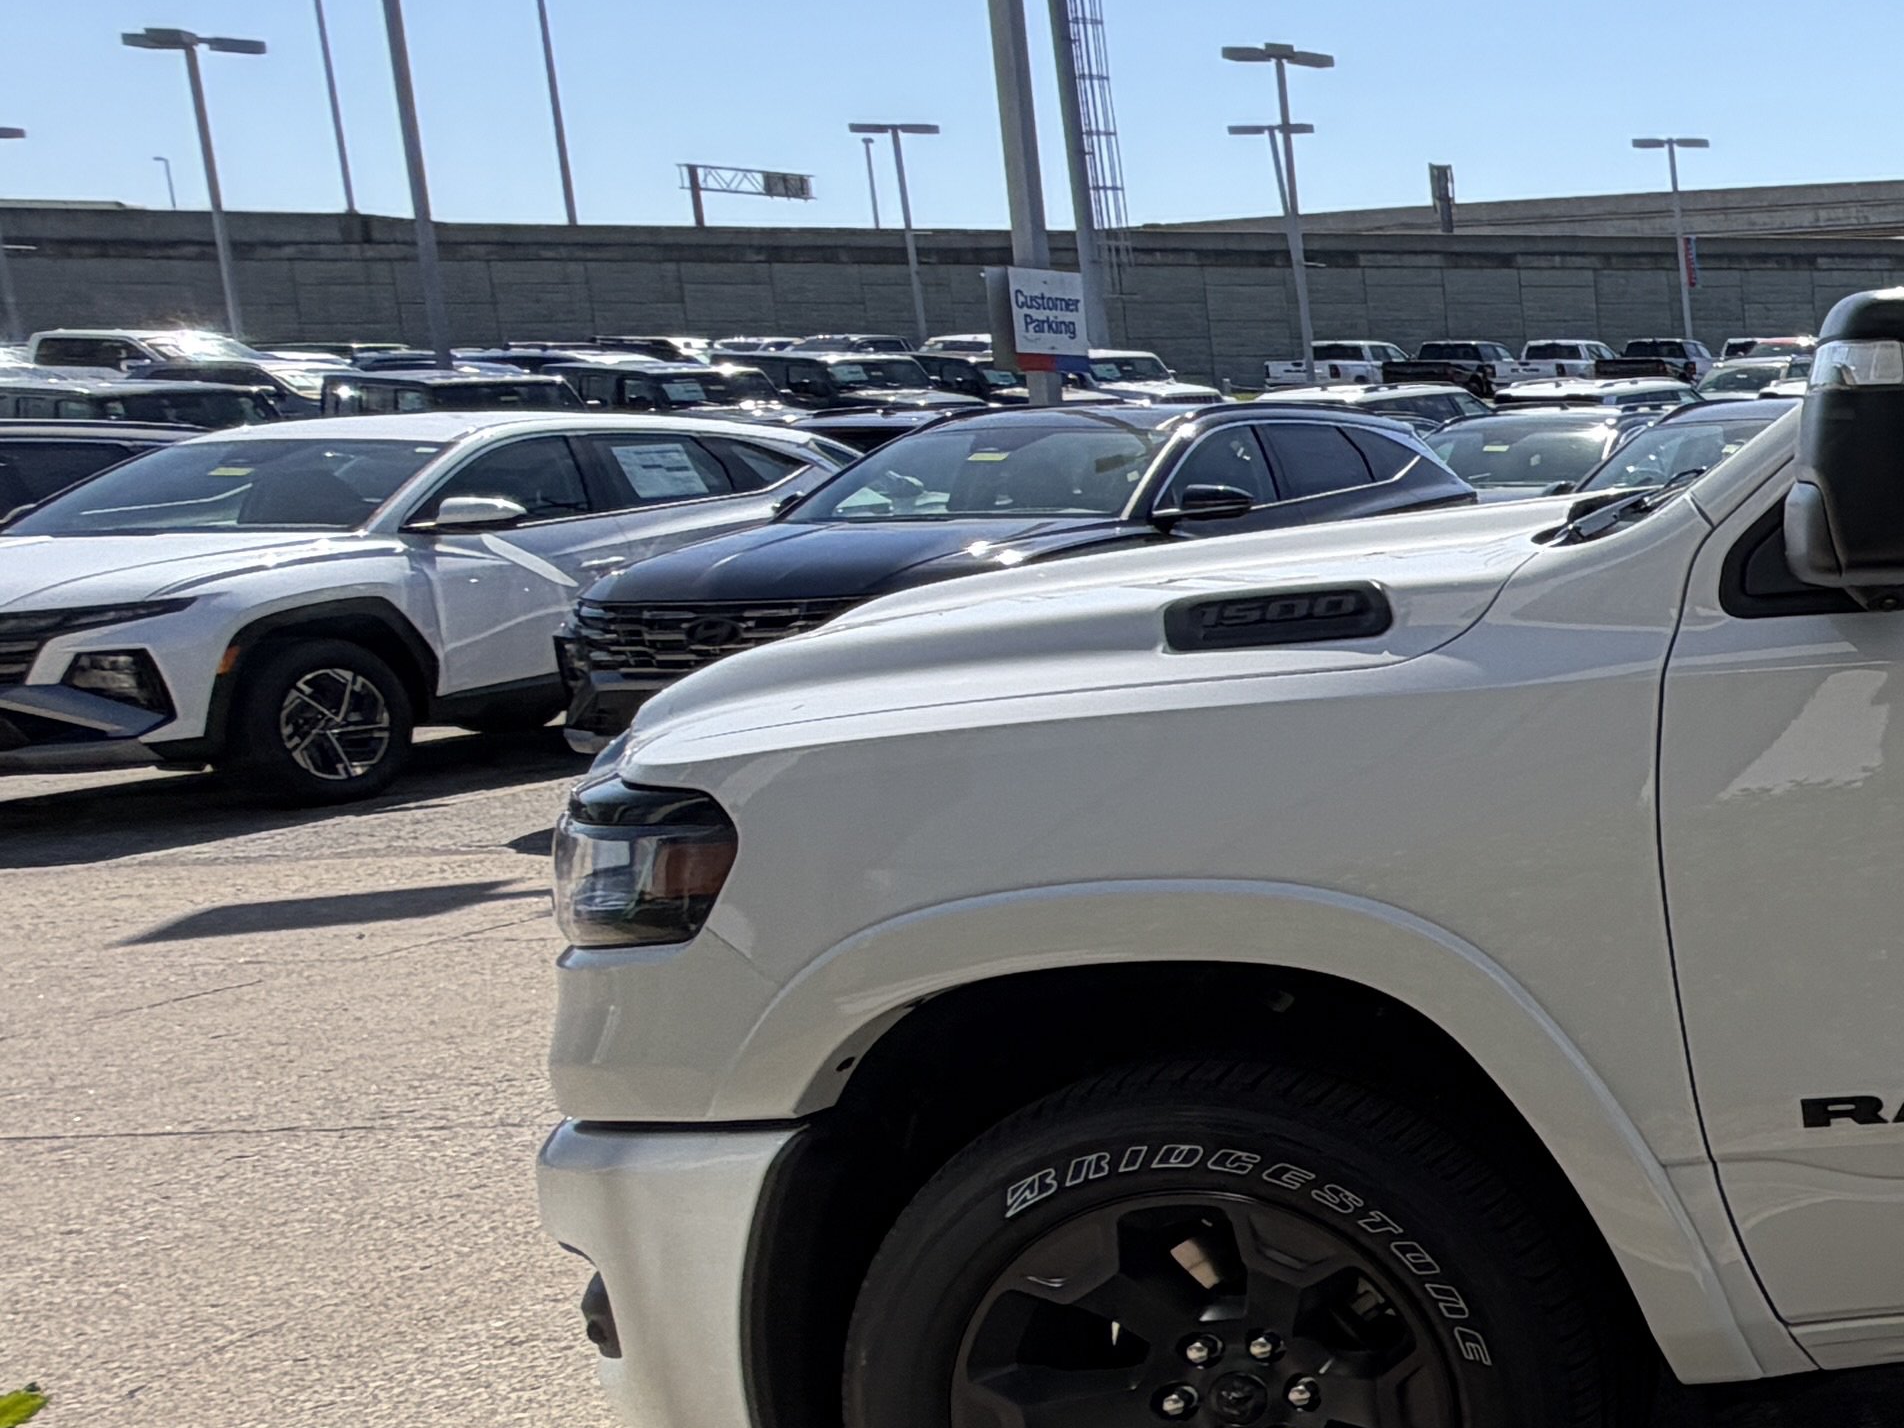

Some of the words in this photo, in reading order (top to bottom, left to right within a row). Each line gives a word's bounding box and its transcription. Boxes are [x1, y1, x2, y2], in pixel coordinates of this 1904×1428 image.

[1014, 289, 1081, 313] Customer
[1023, 313, 1077, 340] Parking
[1201, 595, 1357, 627] 1500
[1005, 1143, 1494, 1368] BRIDGESTONE
